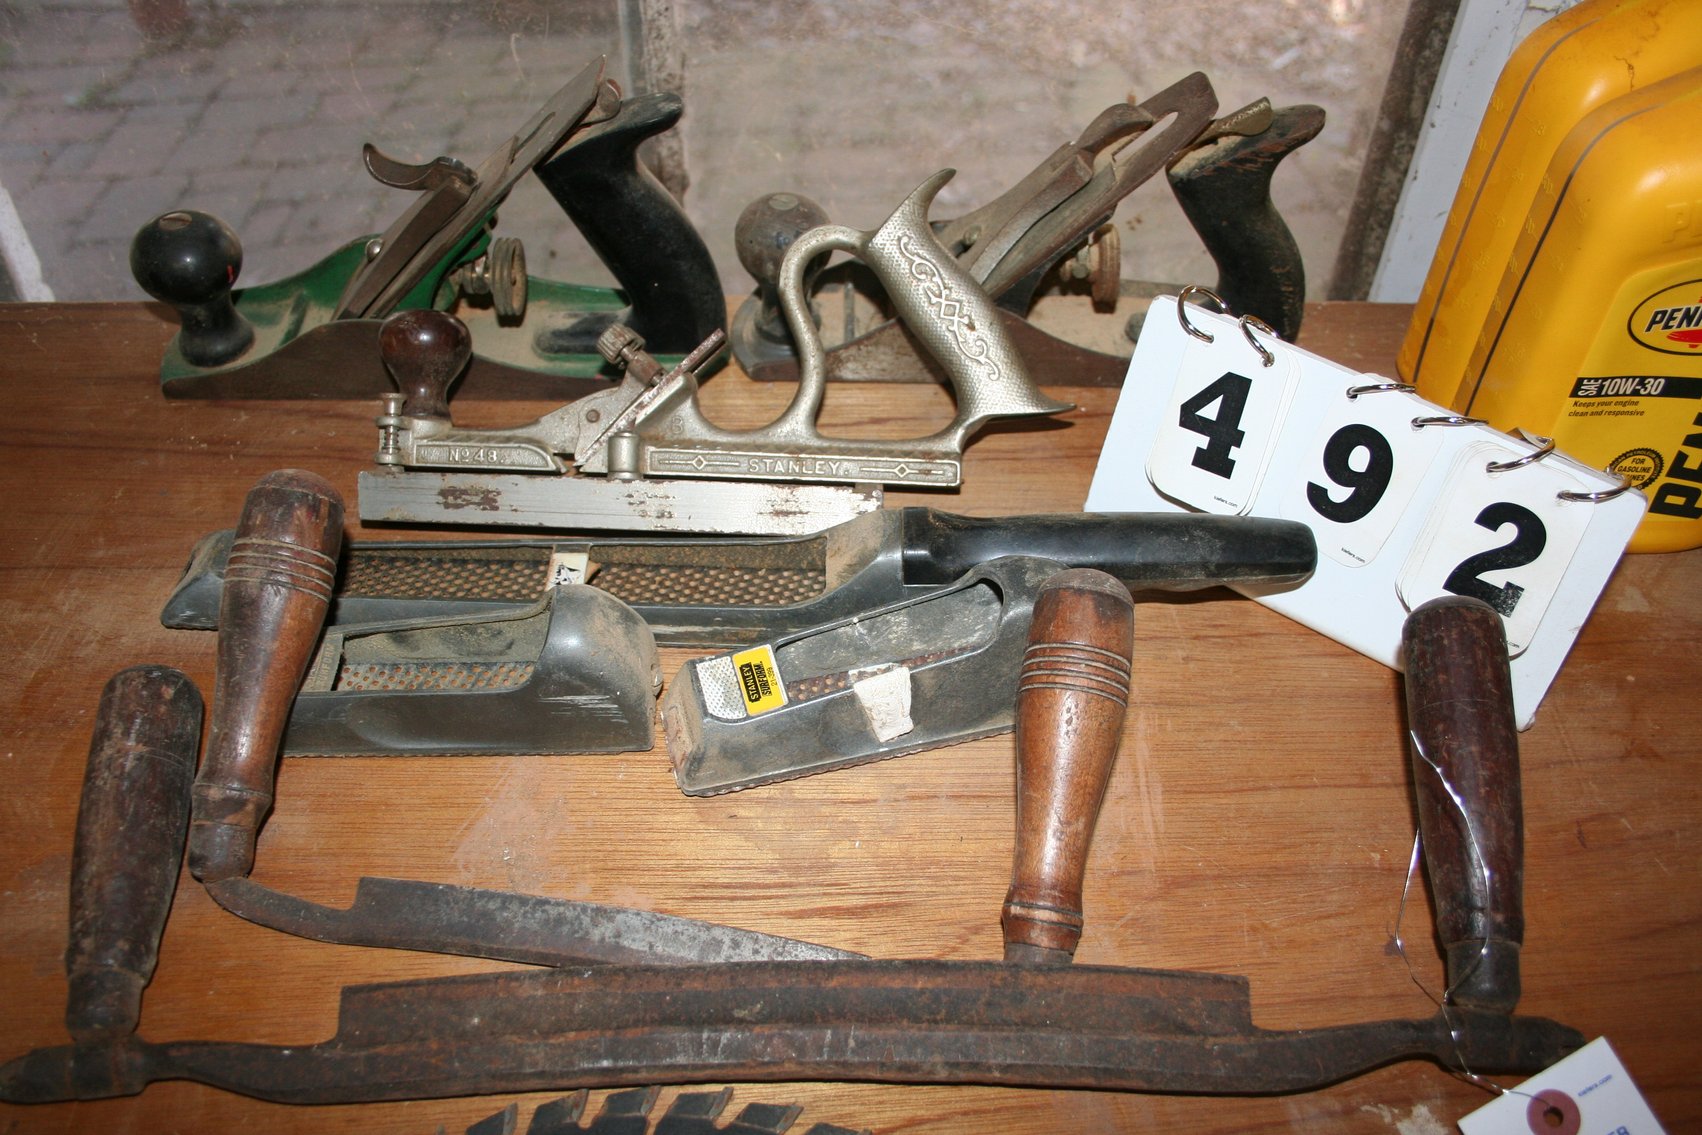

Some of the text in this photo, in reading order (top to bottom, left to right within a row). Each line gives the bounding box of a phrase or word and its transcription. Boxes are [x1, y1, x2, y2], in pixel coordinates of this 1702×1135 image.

[1644, 305, 1702, 333] PEN
[1577, 378, 1665, 396] SAE 10W-30
[1572, 400, 1596, 408] Keeps
[1614, 399, 1640, 407] engine
[1604, 409, 1645, 417] responsive
[1617, 465, 1652, 473] GASOLINE
[1178, 371, 1547, 618] 4 9 2
[742, 666, 760, 700] STANLEY
